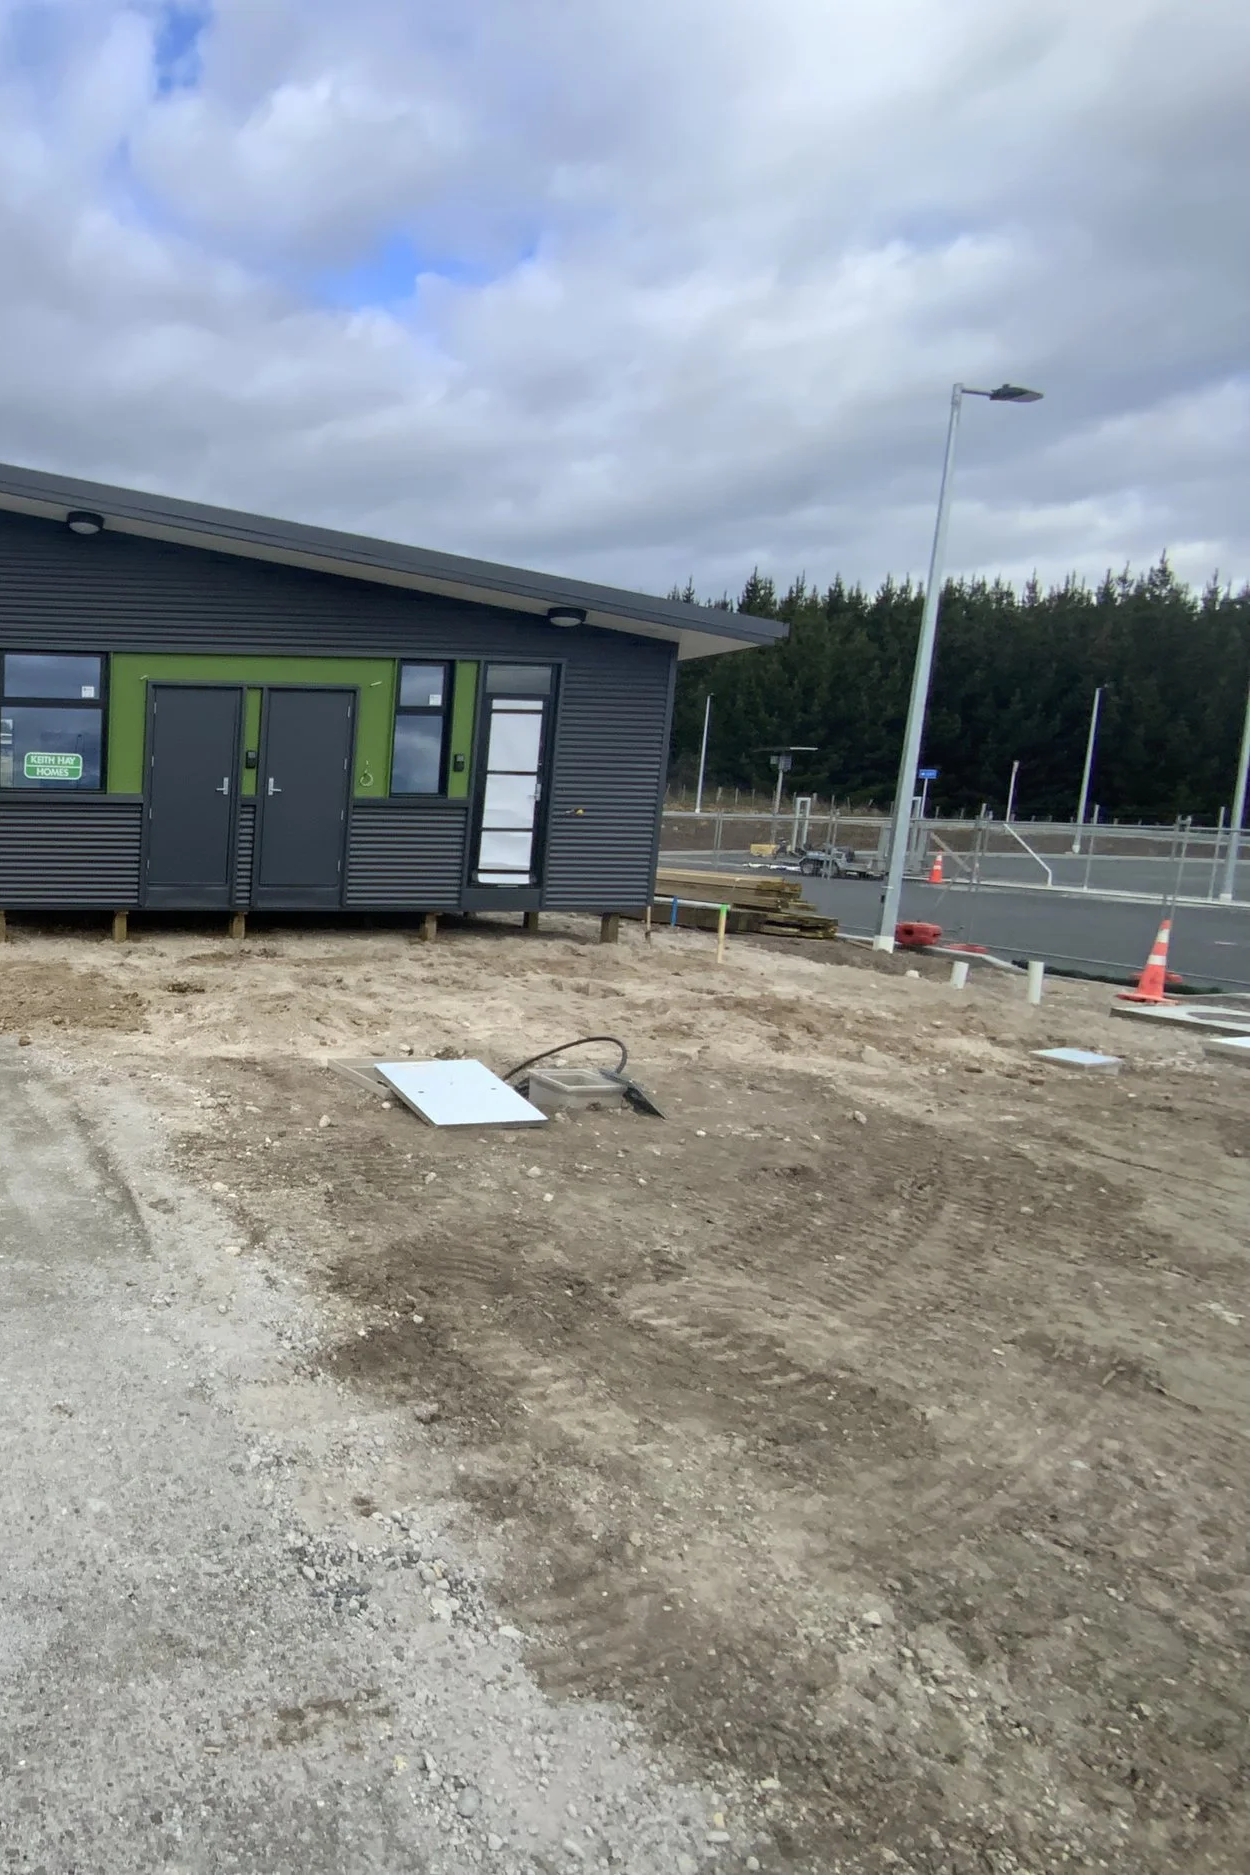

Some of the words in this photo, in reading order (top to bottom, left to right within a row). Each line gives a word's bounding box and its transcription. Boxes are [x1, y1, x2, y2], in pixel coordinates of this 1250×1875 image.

[30, 755, 55, 764] KEITH
[57, 756, 76, 765] HAY
[36, 767, 69, 777] HOMES
